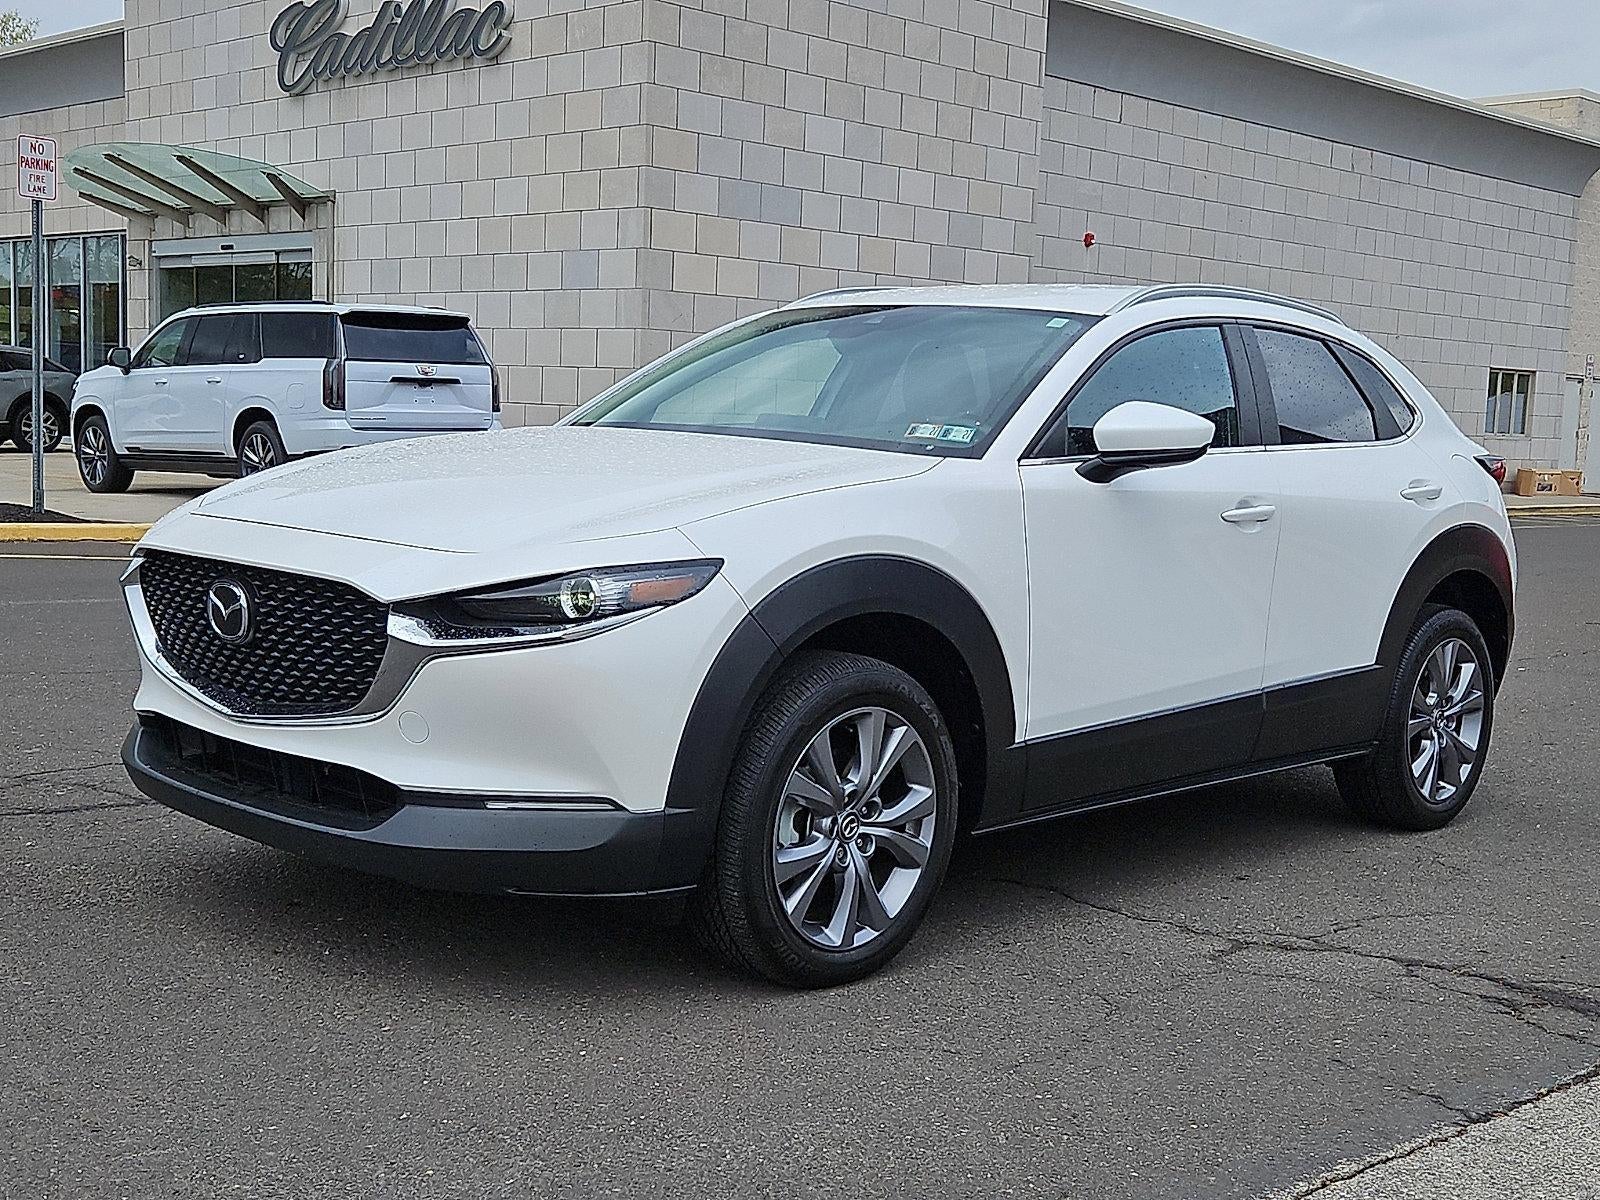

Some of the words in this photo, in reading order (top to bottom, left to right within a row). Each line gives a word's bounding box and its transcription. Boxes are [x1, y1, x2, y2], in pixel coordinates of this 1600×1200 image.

[270, 0, 512, 93] Cadillac
[30, 142, 44, 155] NO
[20, 156, 54, 172] PARKING
[29, 174, 46, 183] FIRE
[28, 184, 47, 194] LANE
